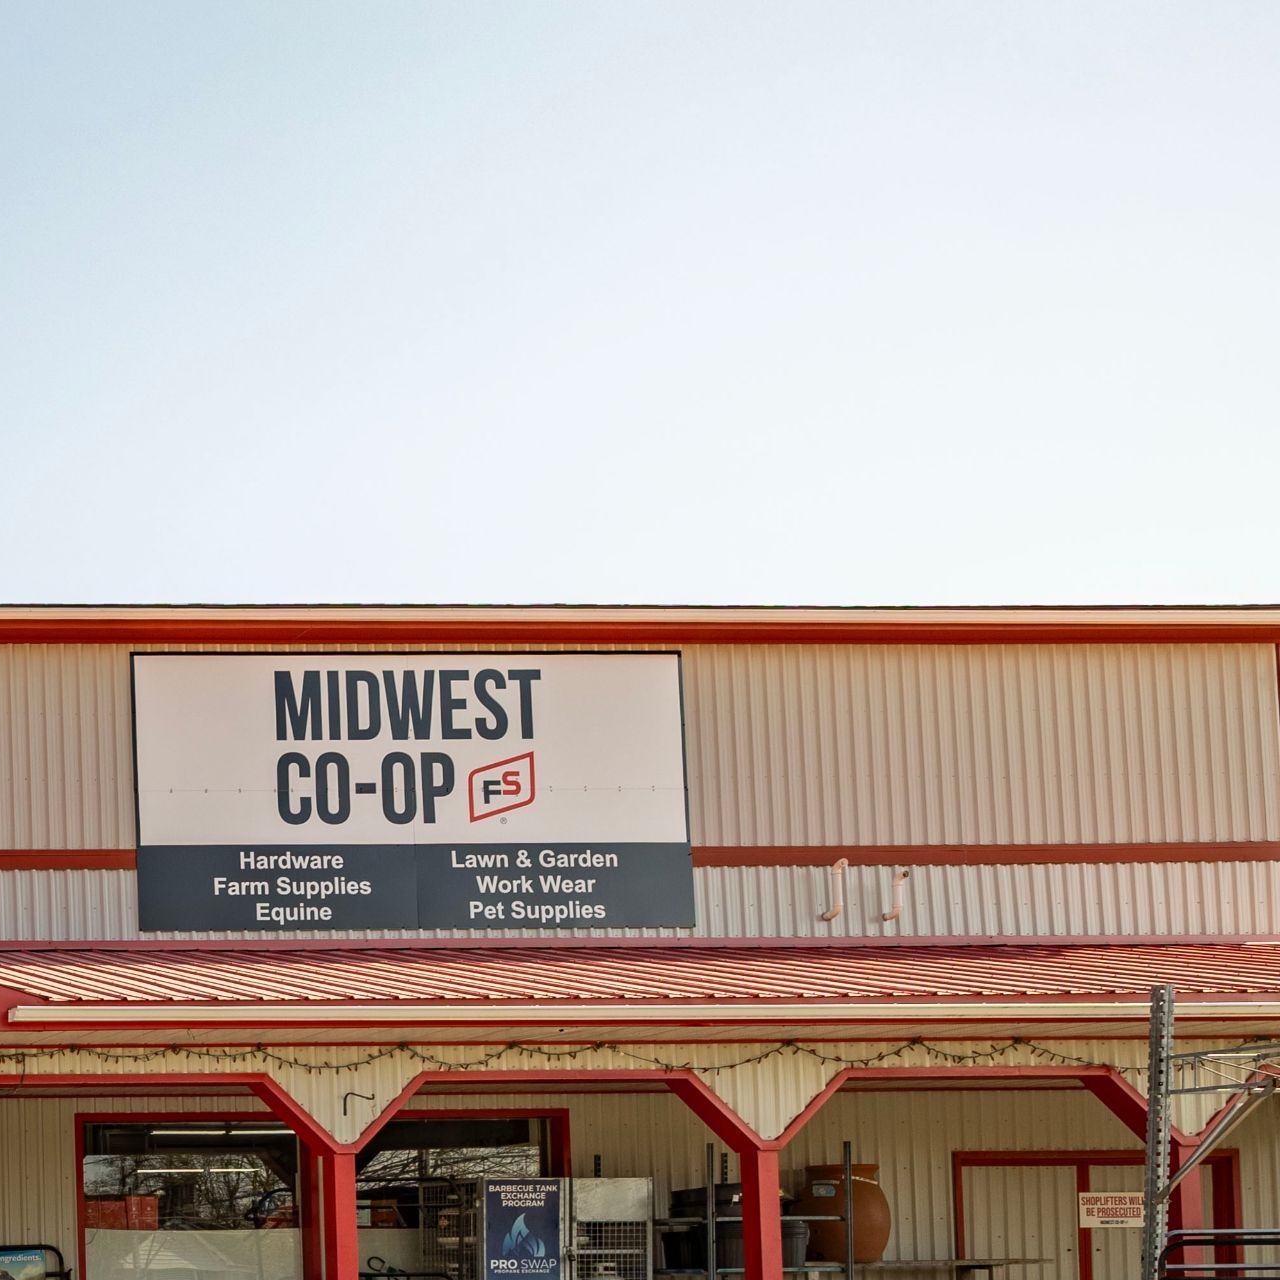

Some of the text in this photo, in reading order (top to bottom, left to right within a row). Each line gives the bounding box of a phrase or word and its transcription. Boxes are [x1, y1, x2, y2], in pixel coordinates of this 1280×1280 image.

[274, 669, 541, 740] MIDWEST
[276, 752, 455, 825] CO-OP
[483, 771, 522, 804] FS
[240, 851, 344, 869] Hardware
[451, 849, 618, 868] Lawn & Garden
[213, 876, 372, 899] Farm Supplies
[476, 875, 596, 893] Work Wear
[256, 903, 332, 925] Equine
[469, 901, 606, 923] Pet Supplies
[1081, 1196, 1127, 1206] SHOPLIFTERS
[1086, 1207, 1141, 1217] BE PROSECUTED
[491, 1258, 557, 1269] PRO SWAP
